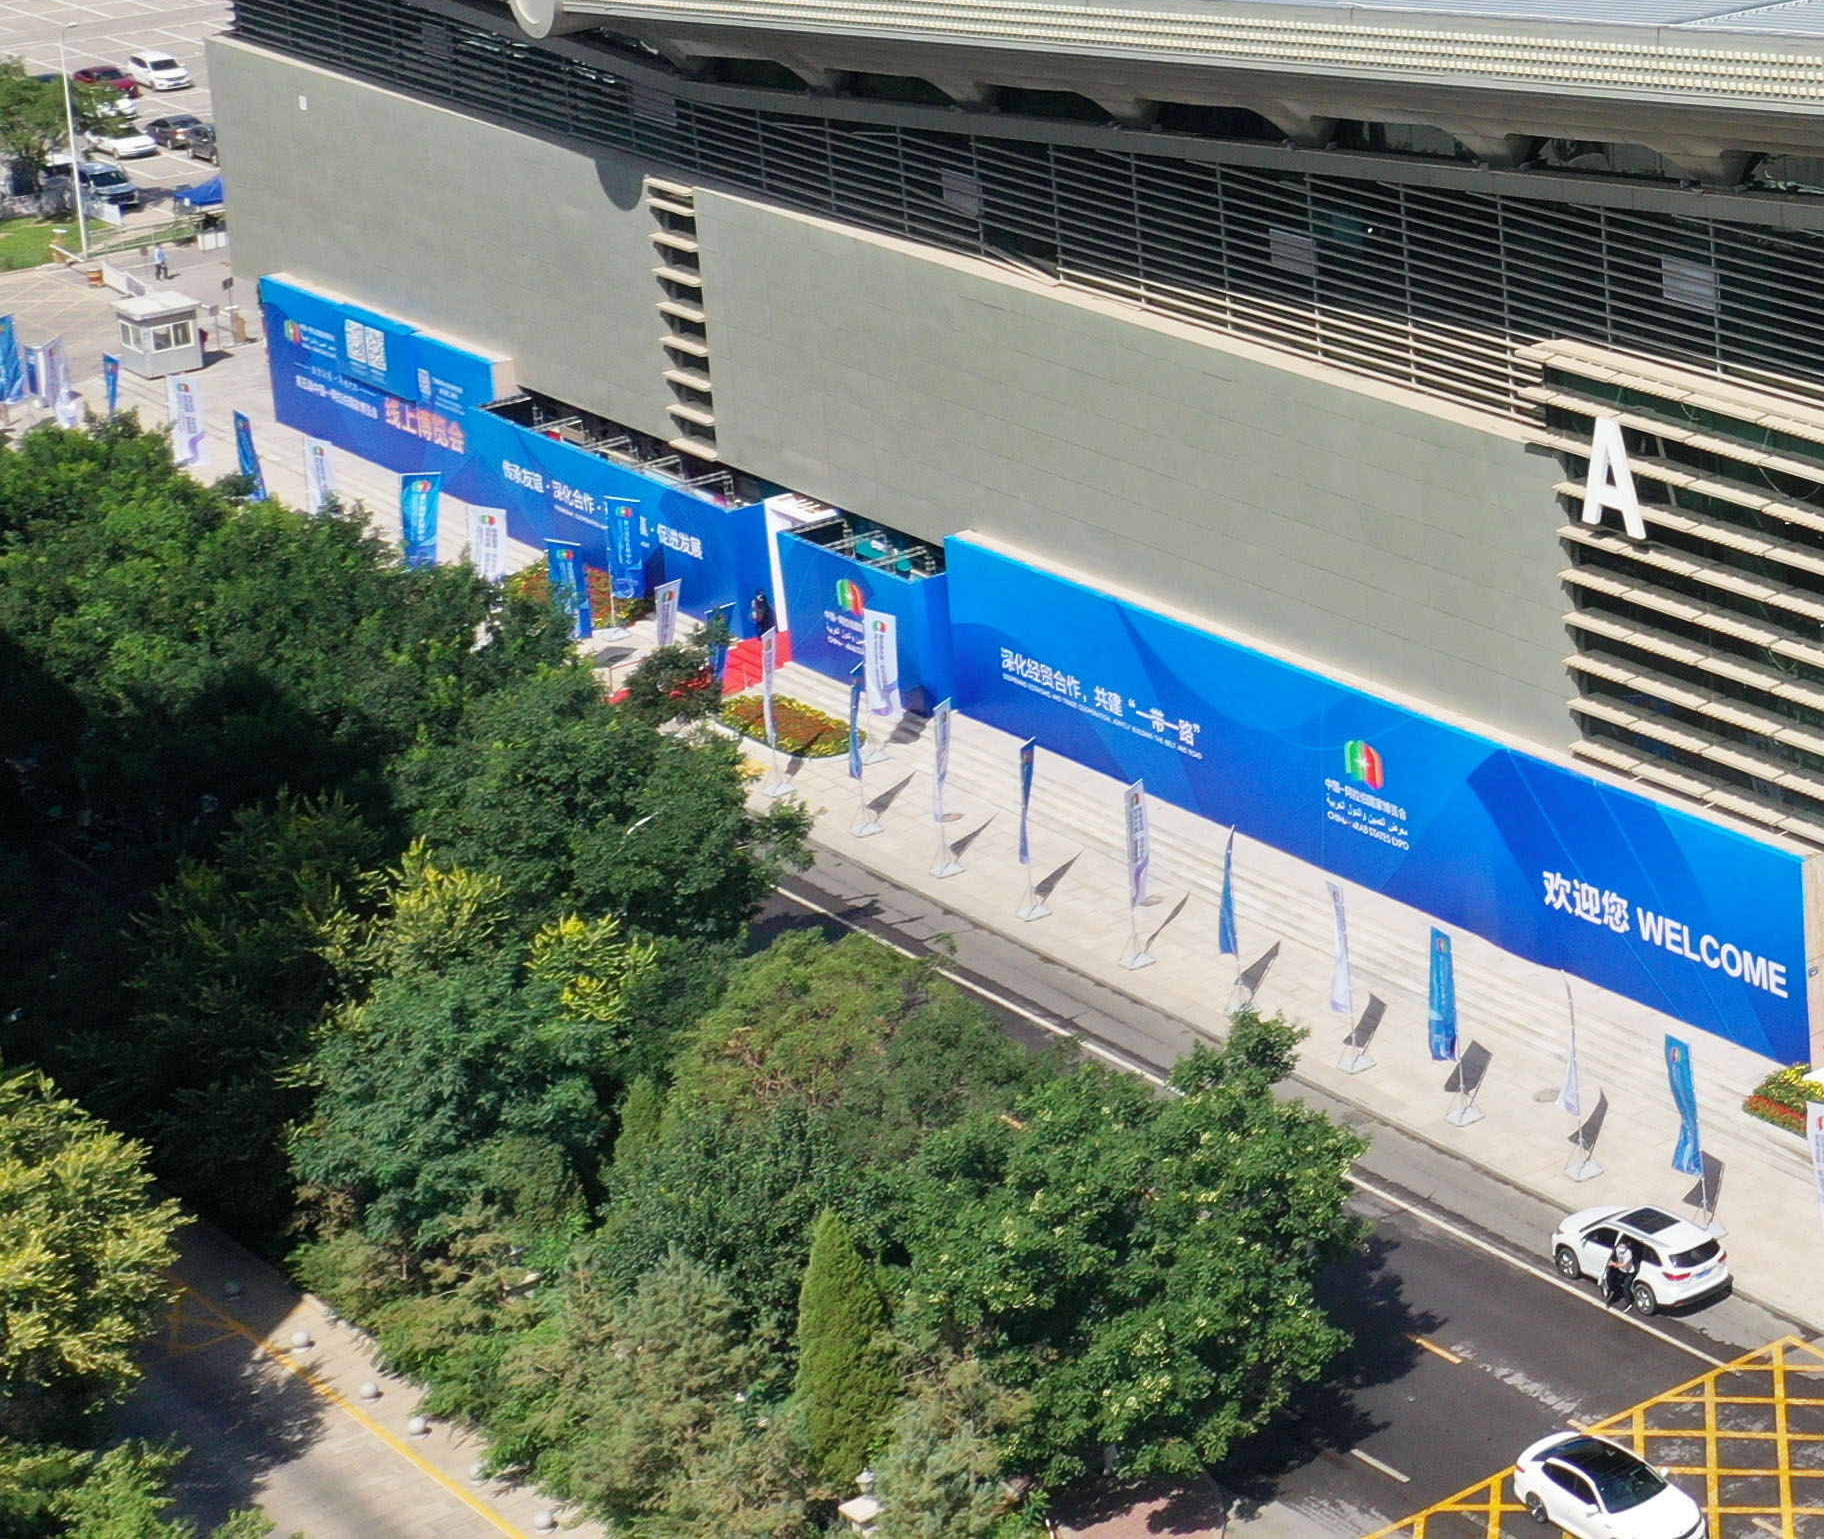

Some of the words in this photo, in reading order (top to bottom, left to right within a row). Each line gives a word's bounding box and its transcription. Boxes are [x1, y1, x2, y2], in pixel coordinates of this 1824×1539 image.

[384, 391, 467, 455] 线上博览会
[1582, 416, 1647, 540] A
[1542, 871, 1630, 934] 欢迎您
[1636, 906, 1789, 999] WELCOME
